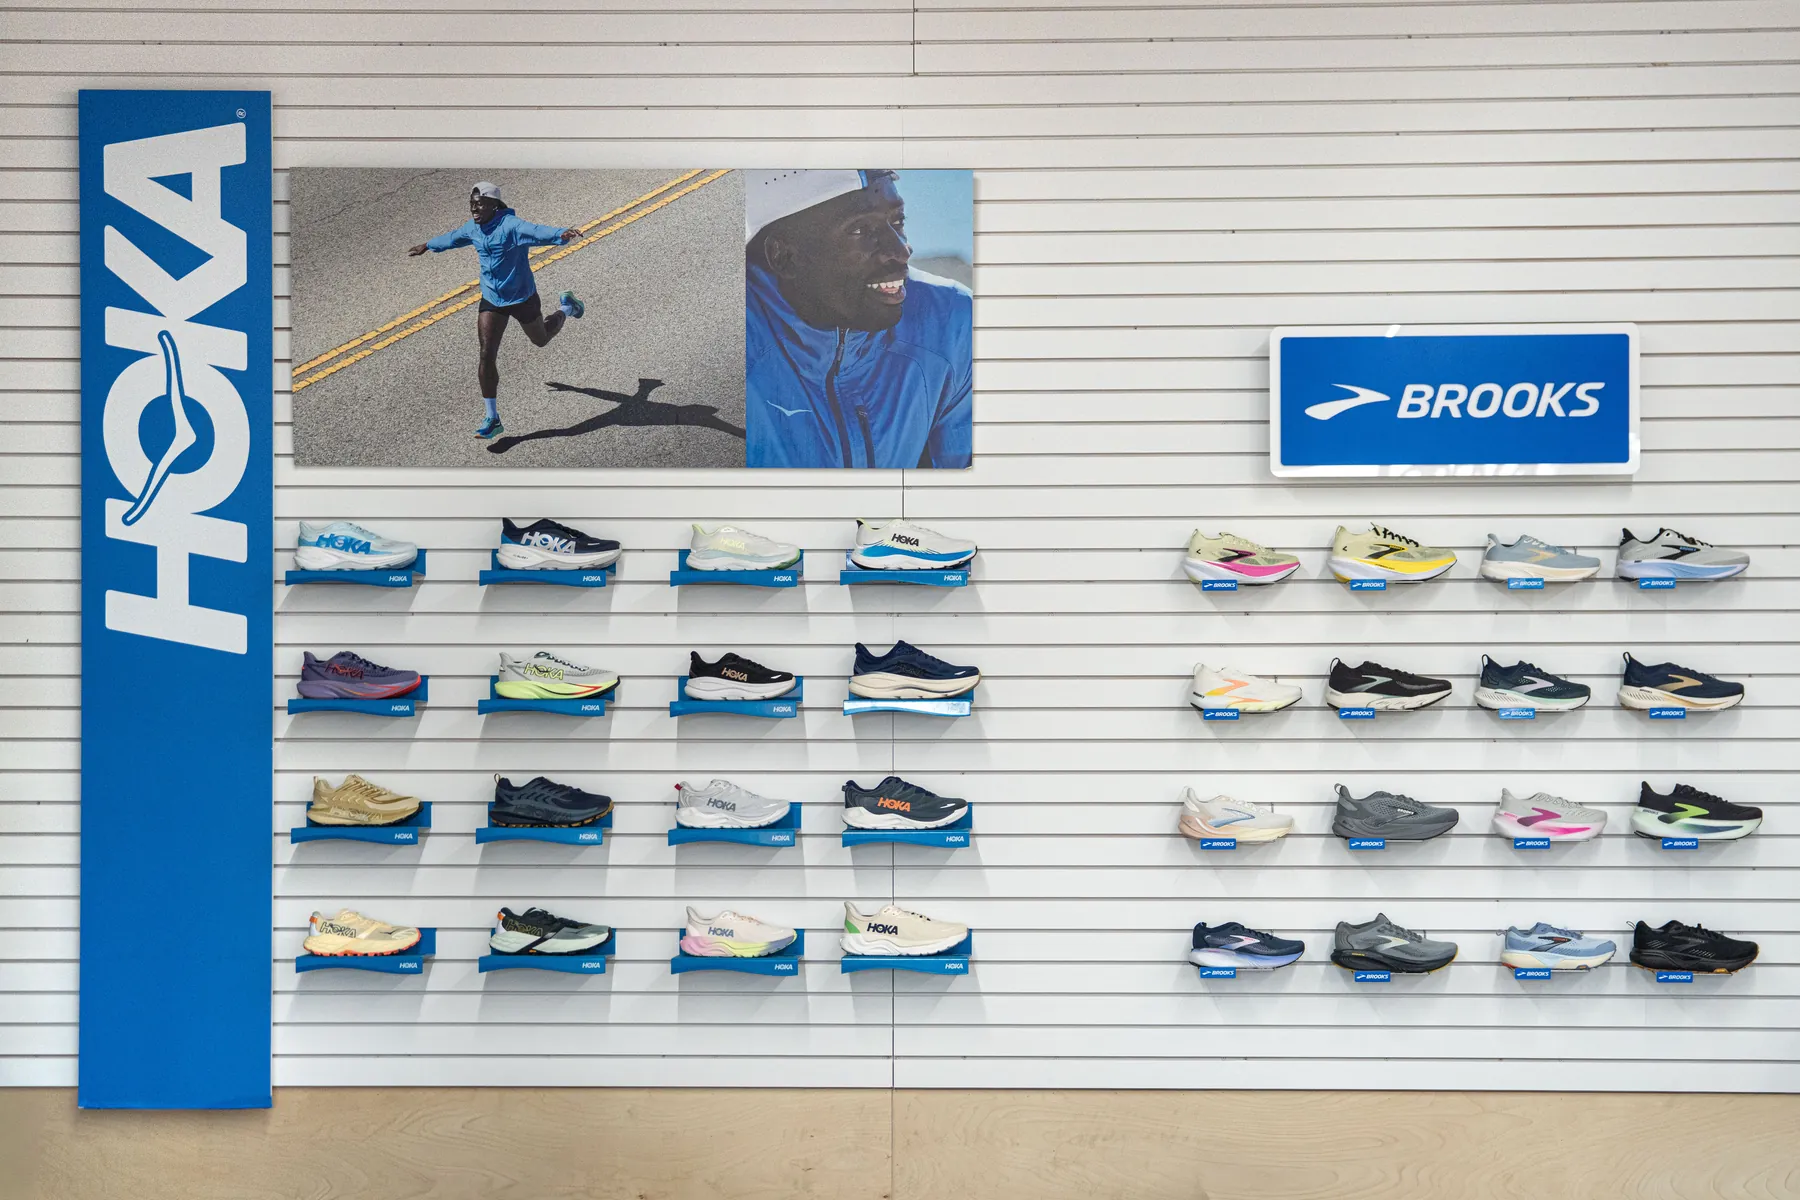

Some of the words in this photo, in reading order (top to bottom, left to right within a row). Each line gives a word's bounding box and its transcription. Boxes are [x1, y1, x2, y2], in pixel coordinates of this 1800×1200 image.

[103, 122, 250, 654] HOKA
[1396, 382, 1606, 418] BROOKS
[316, 533, 373, 554] HOKA
[521, 531, 576, 555] HOKA
[720, 537, 746, 551] HOKA
[891, 533, 919, 547] HOKA
[943, 574, 963, 582] HOKA
[325, 664, 365, 680] HOKA
[523, 662, 565, 680] HOKA
[721, 667, 748, 682] HOKA
[707, 797, 737, 812] HOKA
[877, 797, 911, 813] HOKA
[578, 833, 598, 841] HOKA
[771, 834, 790, 842] HOKA
[945, 835, 965, 843] HOKA
[319, 922, 357, 938] HOKA
[505, 919, 543, 937] HOKA
[707, 926, 734, 938] HOKA
[866, 922, 898, 936] HOKA
[774, 963, 793, 971] HOKA
[944, 962, 964, 970] HOKA
